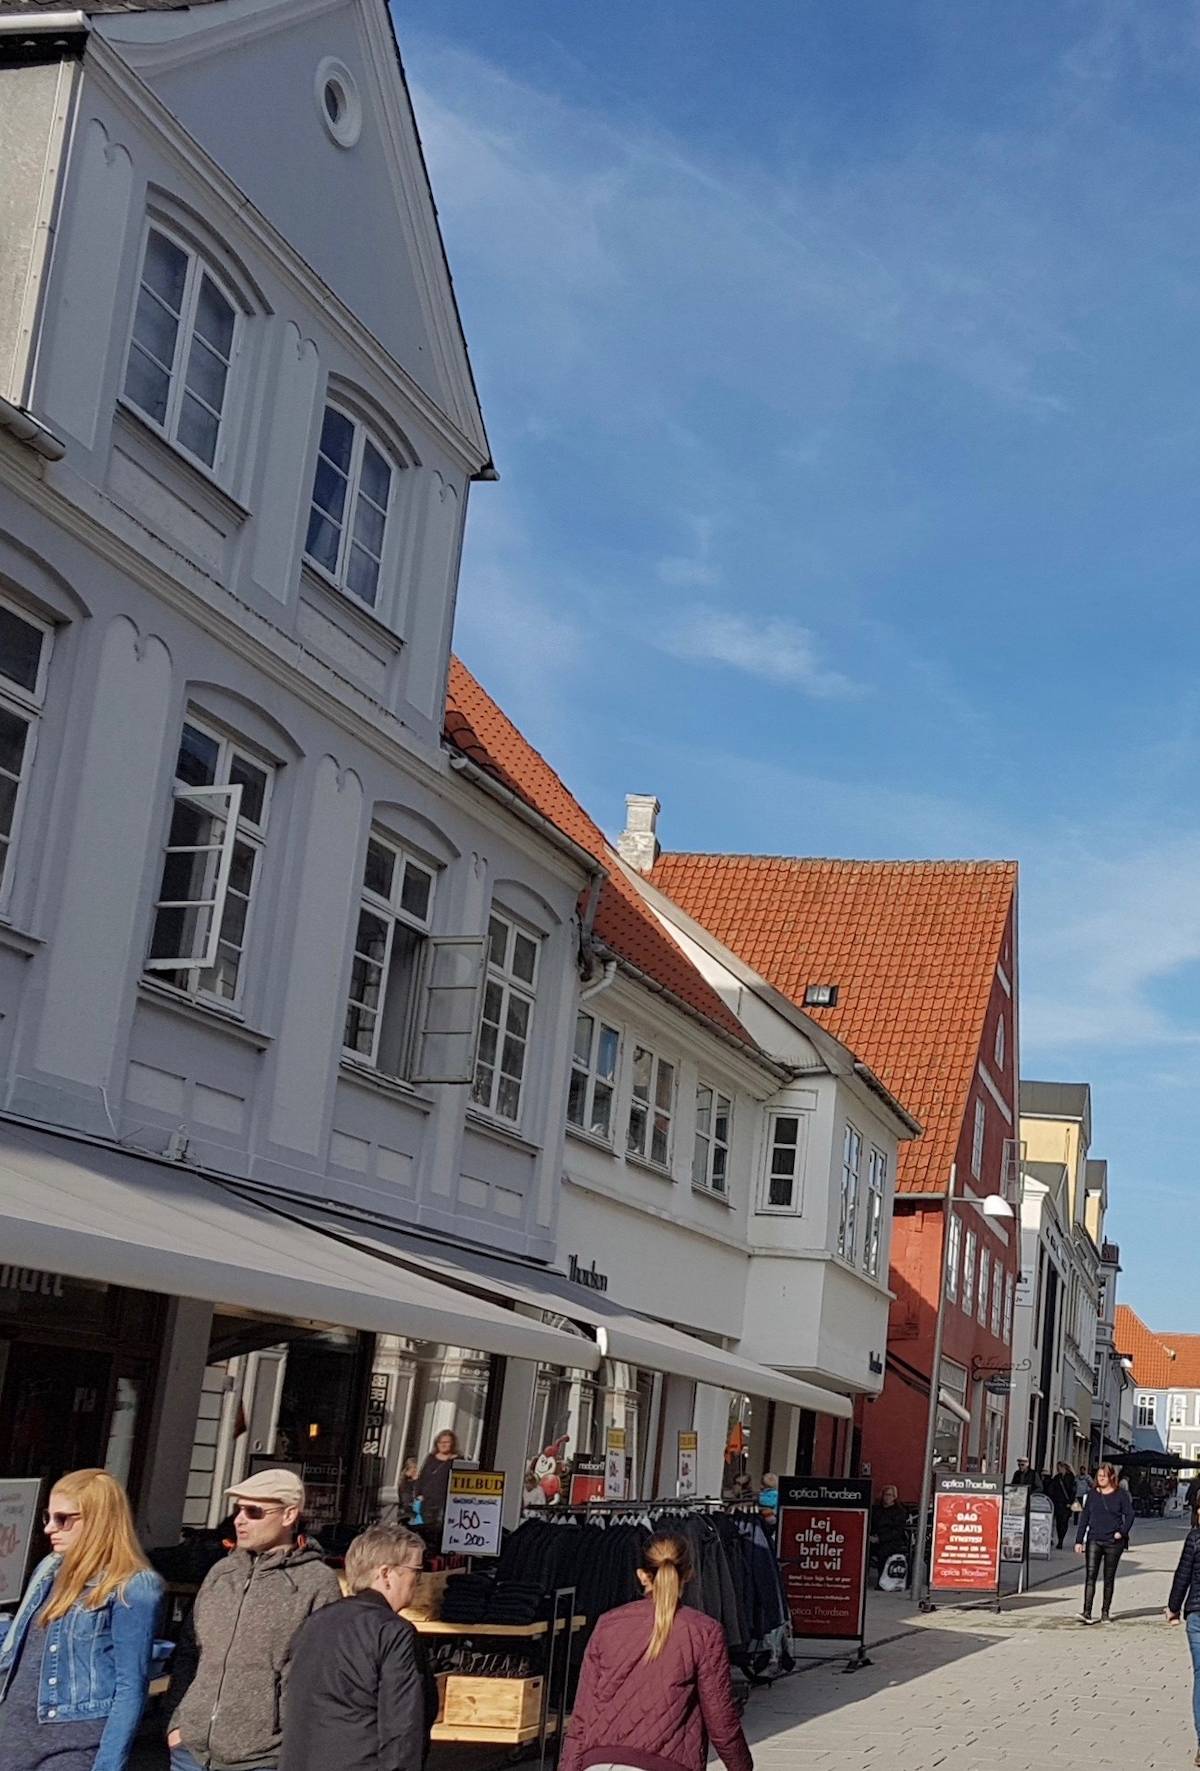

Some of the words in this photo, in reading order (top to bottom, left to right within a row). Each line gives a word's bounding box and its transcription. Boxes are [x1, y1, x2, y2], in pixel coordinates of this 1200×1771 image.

[453, 1477, 504, 1490] TILBUD
[942, 1480, 963, 1490] optica
[965, 1479, 996, 1489] Thordsen
[789, 1488, 818, 1500] optica
[820, 1487, 861, 1499] Thordsen
[811, 1517, 831, 1532] Lej
[951, 1524, 982, 1533] GRATIS
[795, 1529, 822, 1542] alle
[826, 1530, 844, 1543] de
[800, 1543, 844, 1556] briller
[801, 1557, 819, 1569] du
[824, 1558, 841, 1570] vil
[791, 1607, 811, 1617] ptica
